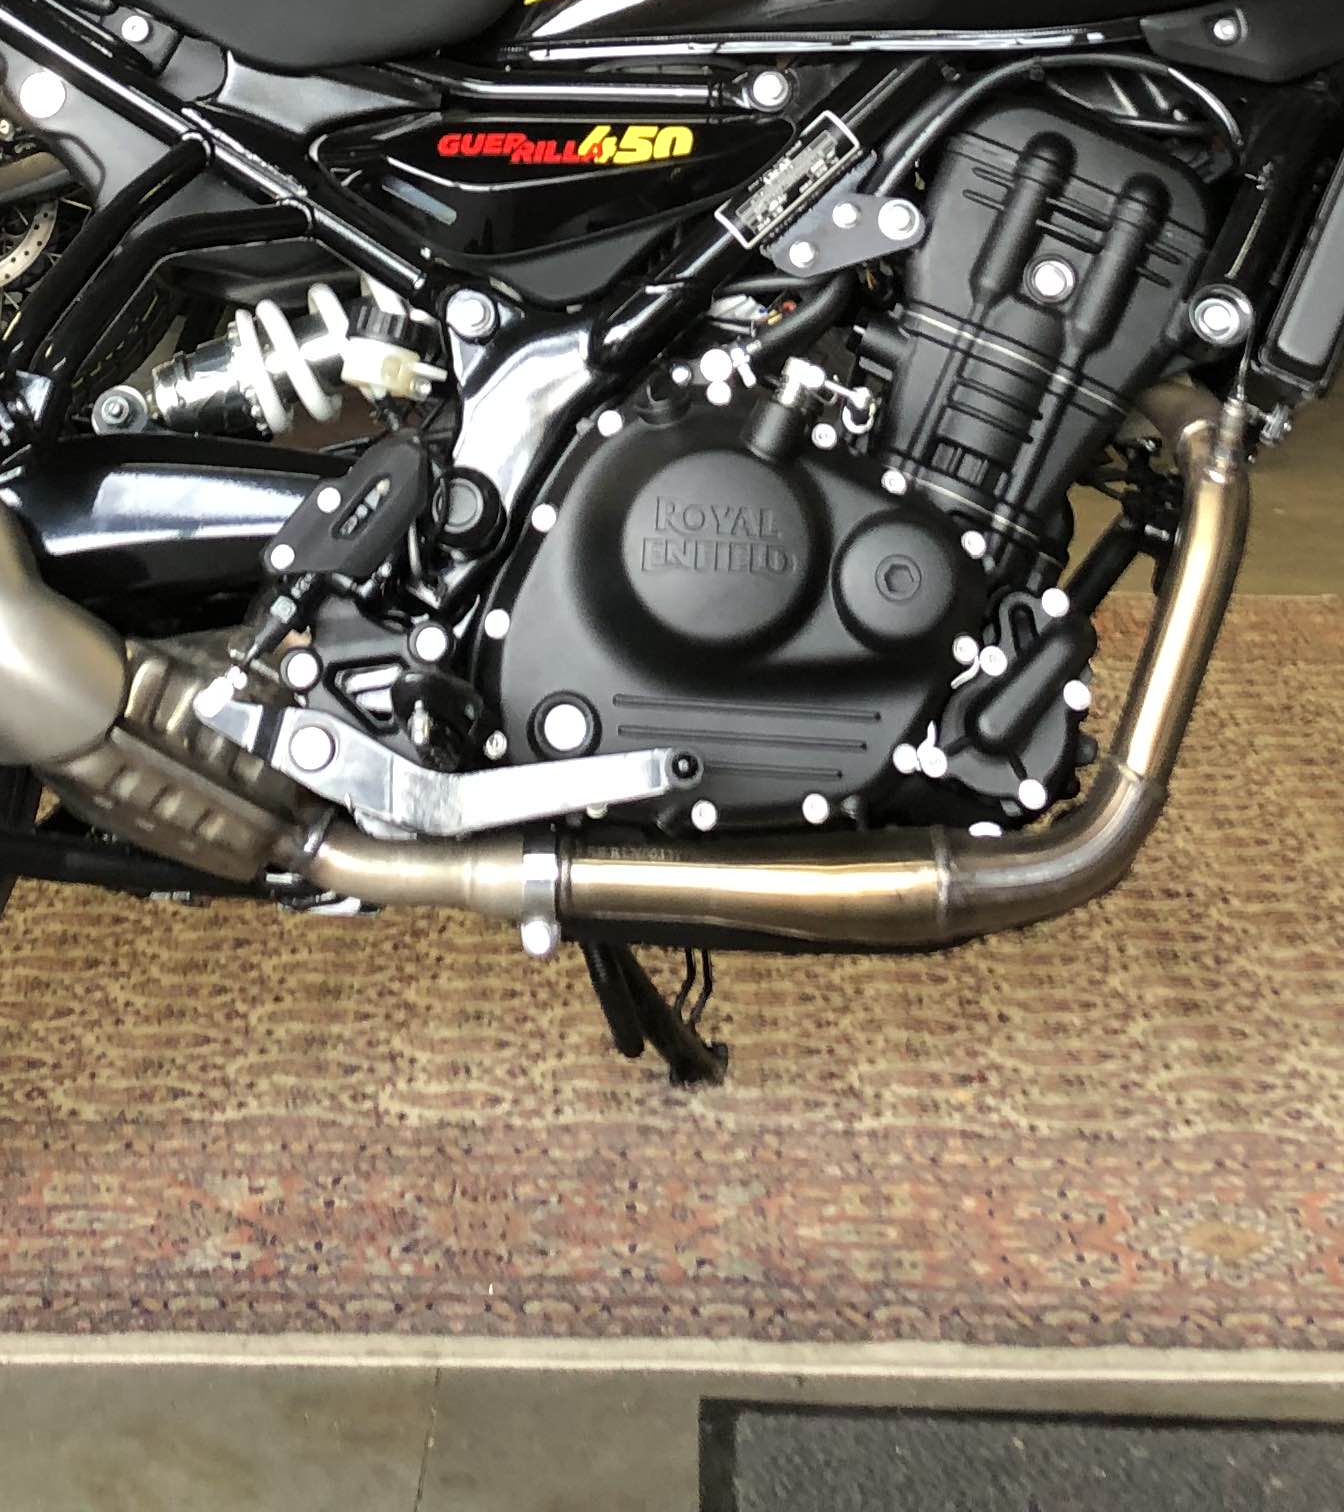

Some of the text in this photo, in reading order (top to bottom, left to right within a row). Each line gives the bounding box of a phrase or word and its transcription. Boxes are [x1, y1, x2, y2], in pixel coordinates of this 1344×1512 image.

[437, 124, 694, 165] GUERRILLA 450
[655, 495, 783, 539] ROYAL
[640, 538, 800, 574] ENFIELD
